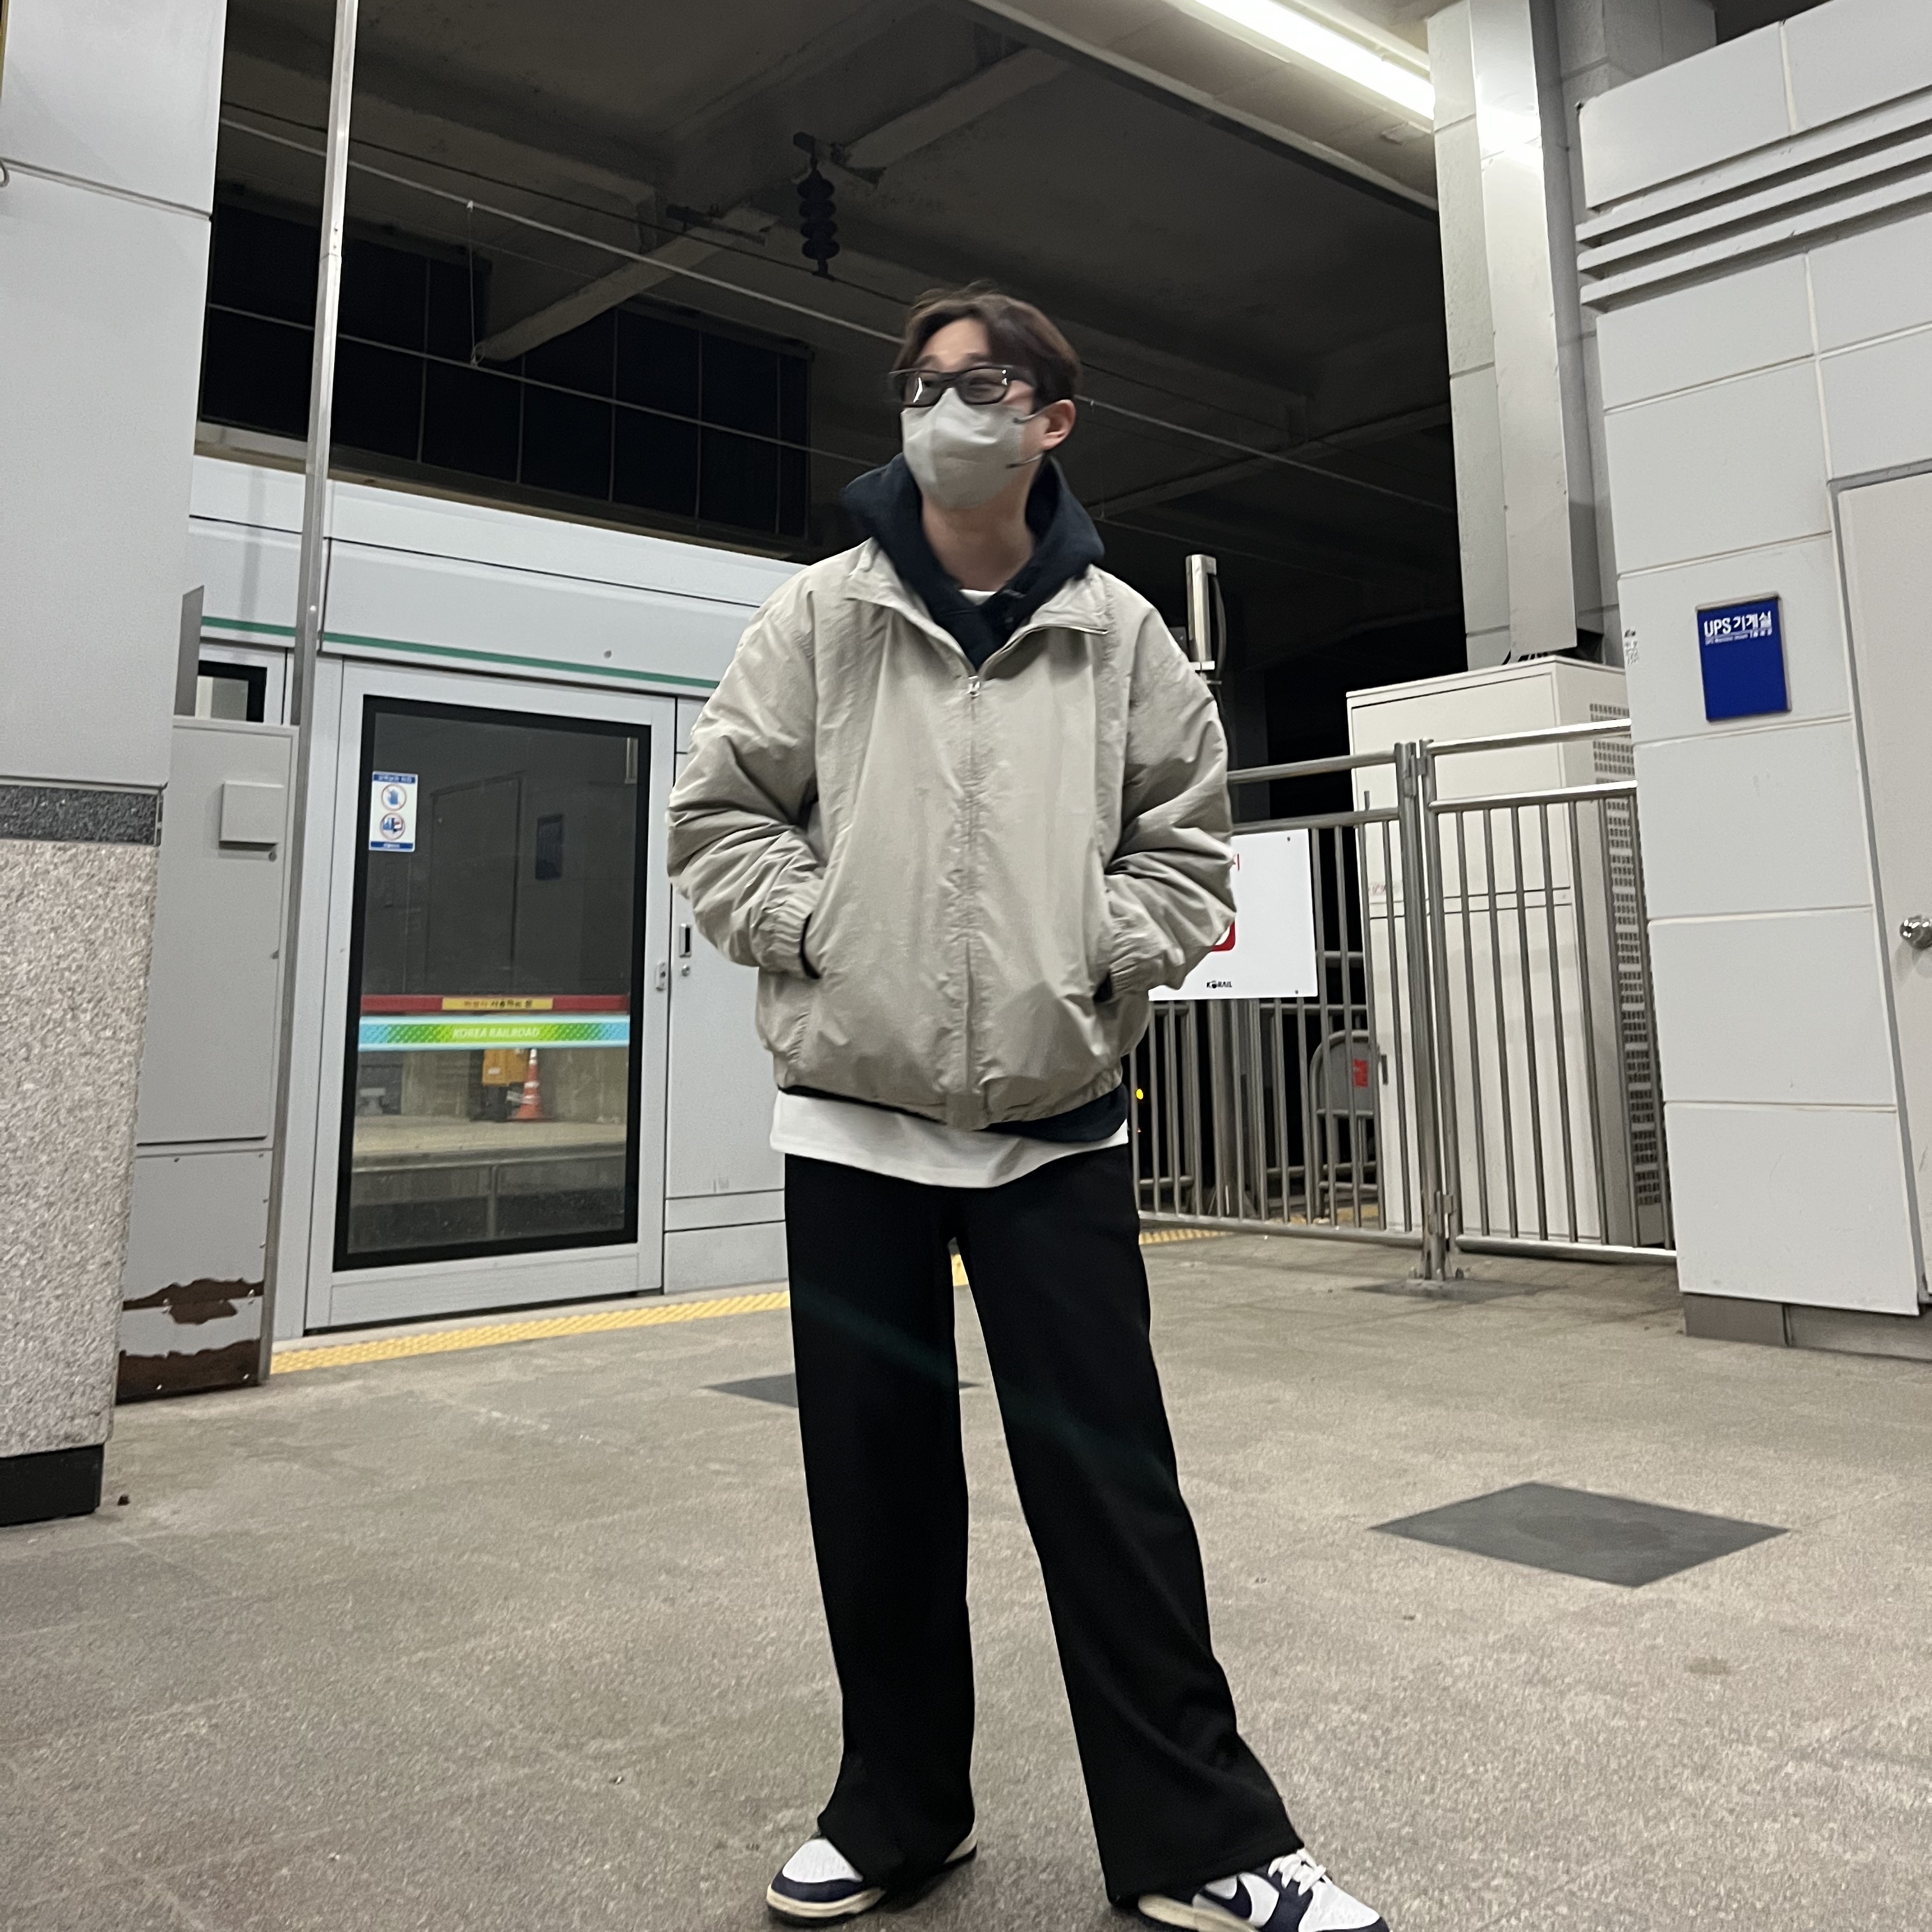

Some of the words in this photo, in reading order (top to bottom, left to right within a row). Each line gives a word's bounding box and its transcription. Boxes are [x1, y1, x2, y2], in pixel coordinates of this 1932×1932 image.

[1704, 618, 1731, 638] UPS
[1733, 611, 1771, 631] 기계실
[452, 1027, 487, 1039] KOREA
[489, 1027, 540, 1038] RAILROAD
